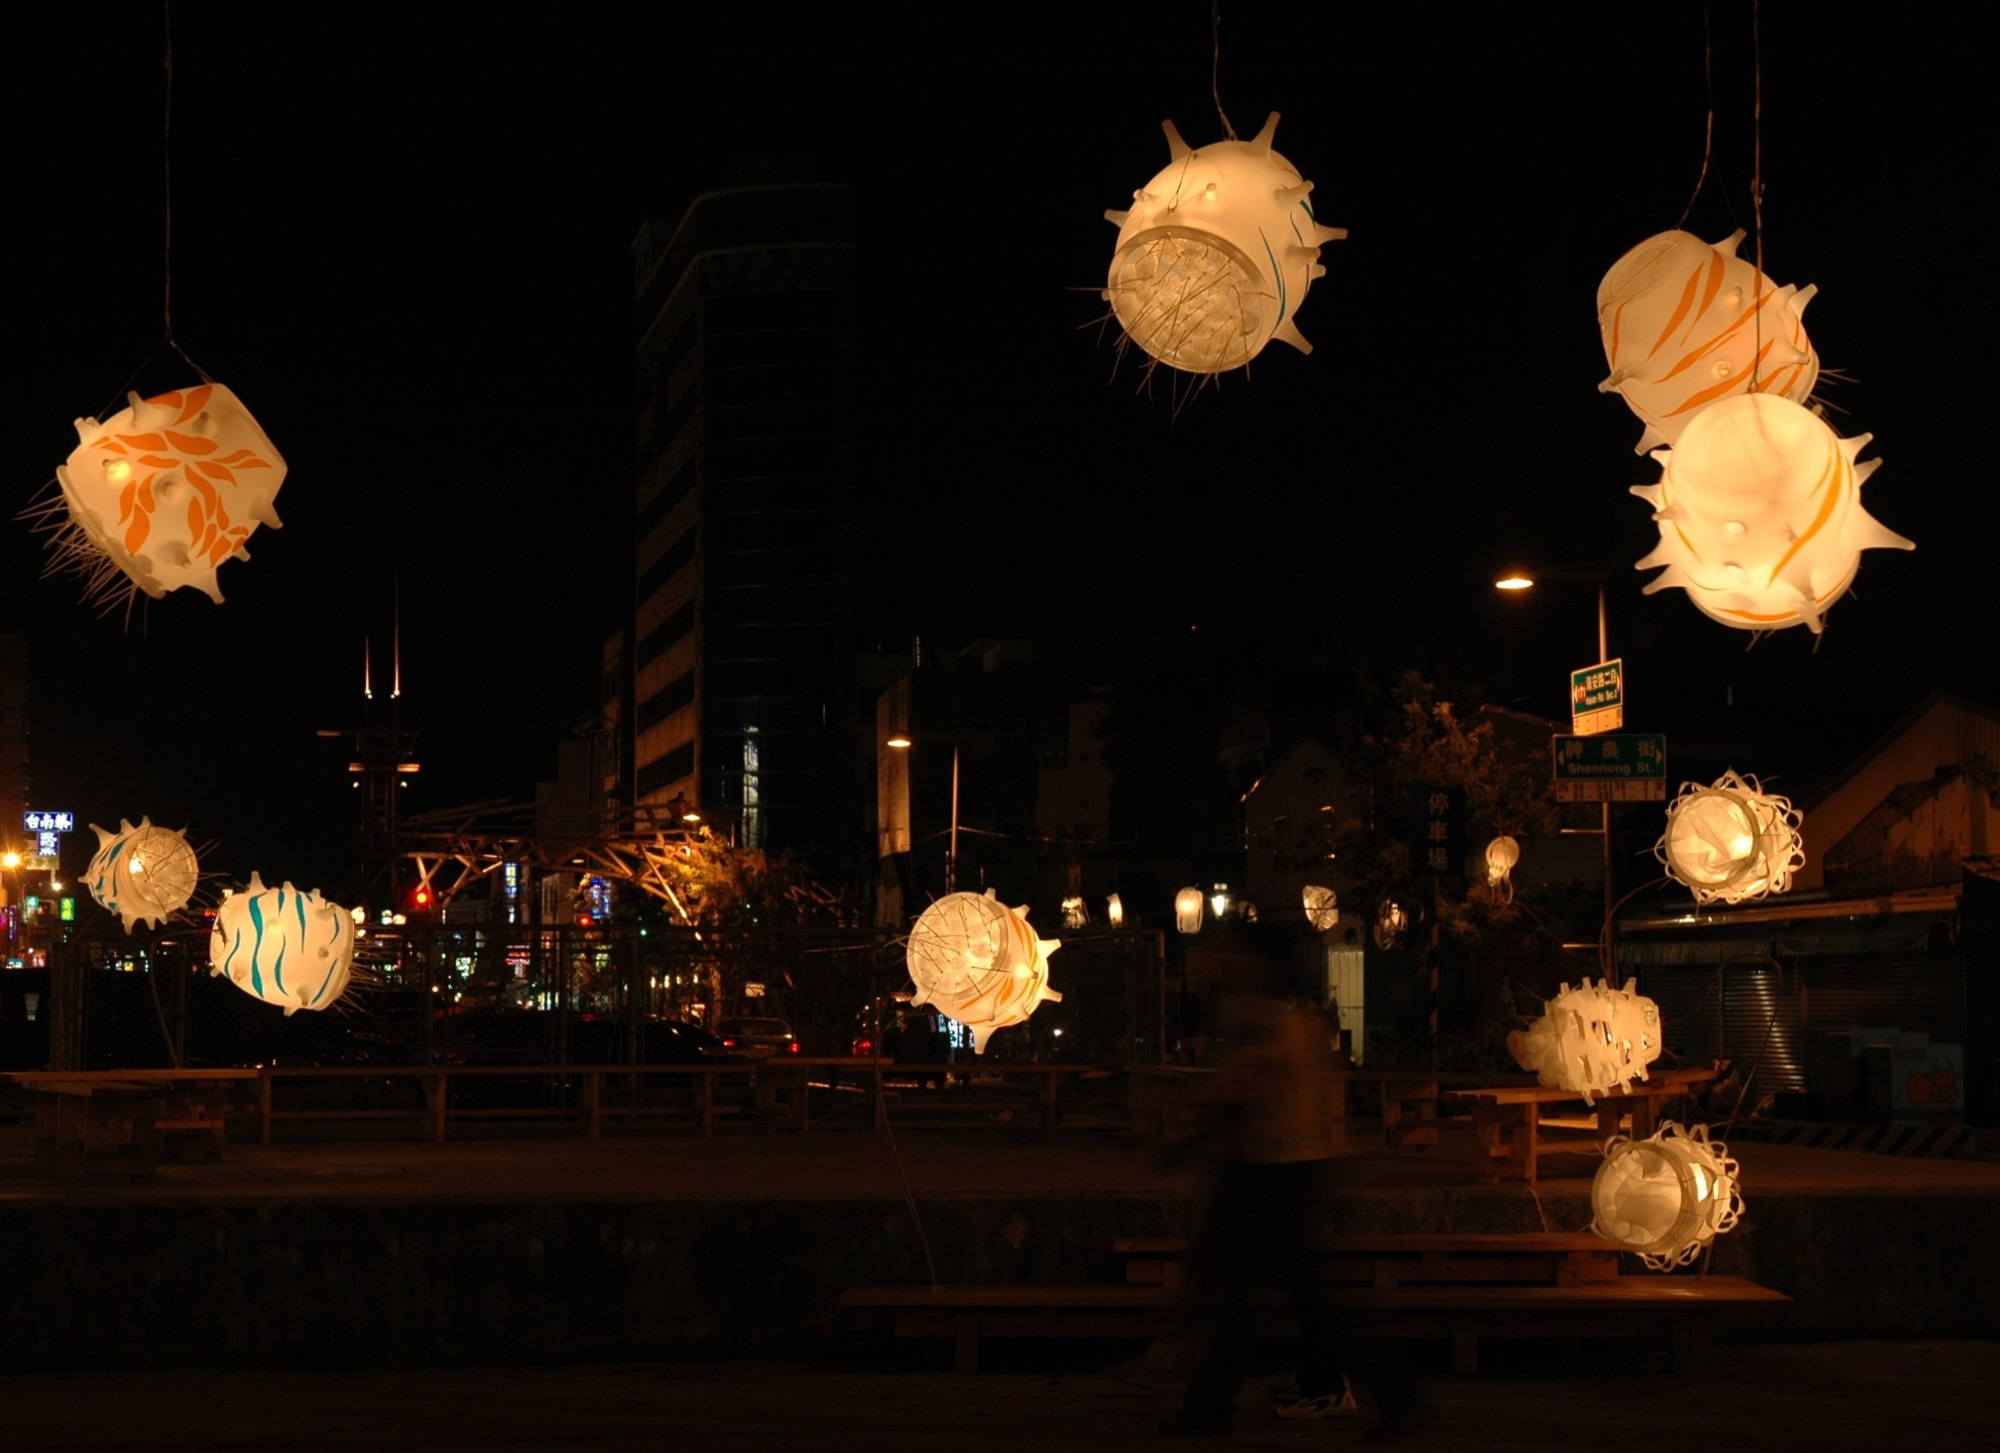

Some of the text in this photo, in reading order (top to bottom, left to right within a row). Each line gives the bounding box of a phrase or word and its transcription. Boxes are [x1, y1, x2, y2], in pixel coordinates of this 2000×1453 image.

[1566, 739, 1656, 760] 神農街
[1568, 760, 1655, 776] Shennong St.
[1427, 792, 1449, 870] 停車場
